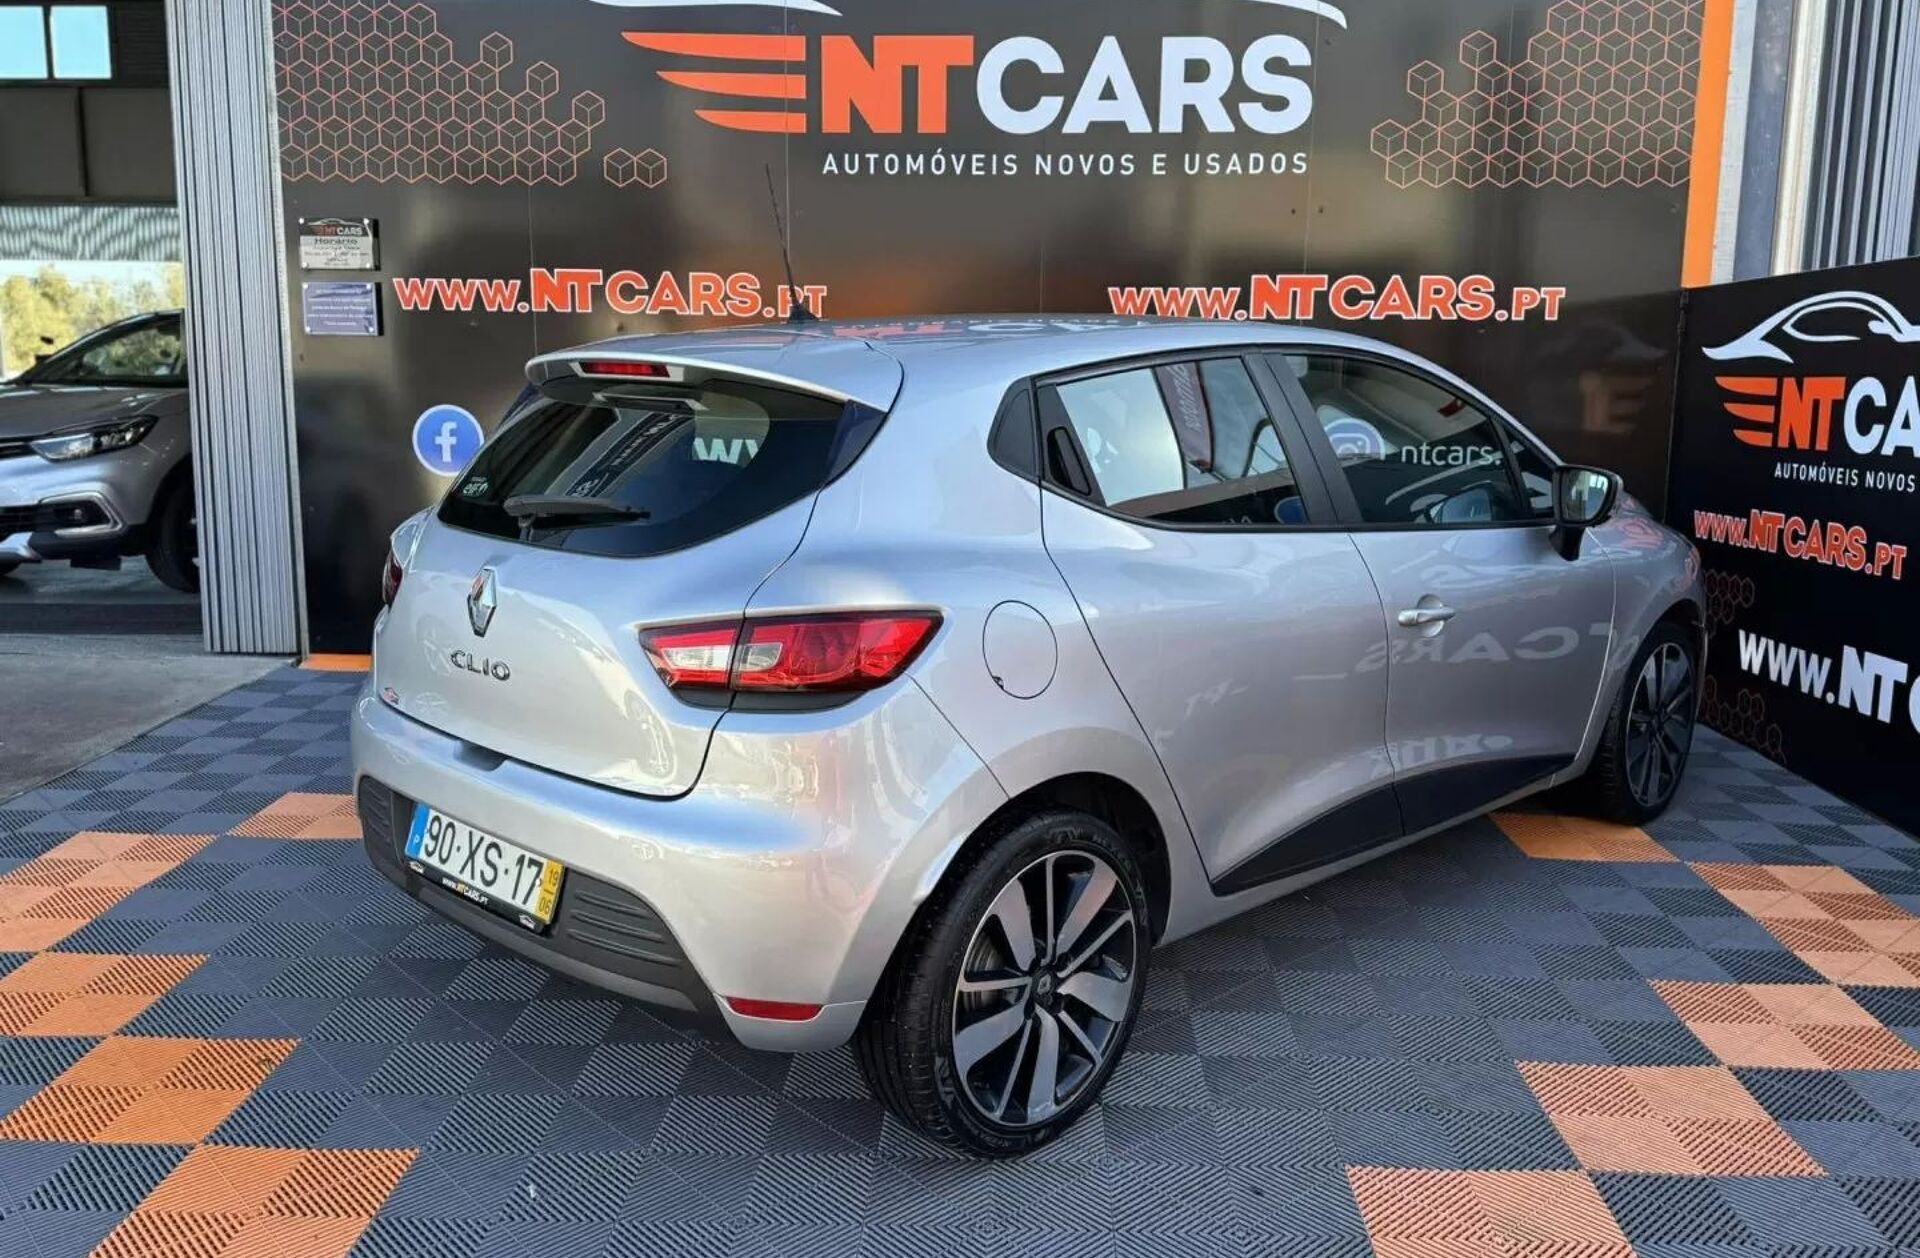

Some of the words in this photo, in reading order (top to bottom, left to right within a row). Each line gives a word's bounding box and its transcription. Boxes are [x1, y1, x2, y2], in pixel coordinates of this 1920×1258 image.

[820, 33, 1313, 135] NTCARS
[822, 147, 1019, 175] AUTOMÓVEIS
[1034, 152, 1136, 175] NOVOS
[1151, 153, 1167, 175] E
[1183, 151, 1308, 175] USADOS
[1774, 461, 1859, 487] AUTOMÓVEIS
[1864, 470, 1917, 493] NOVOS
[450, 649, 511, 682] CLIO
[412, 834, 420, 844] P
[549, 868, 560, 887] 19
[538, 896, 552, 915] 06
